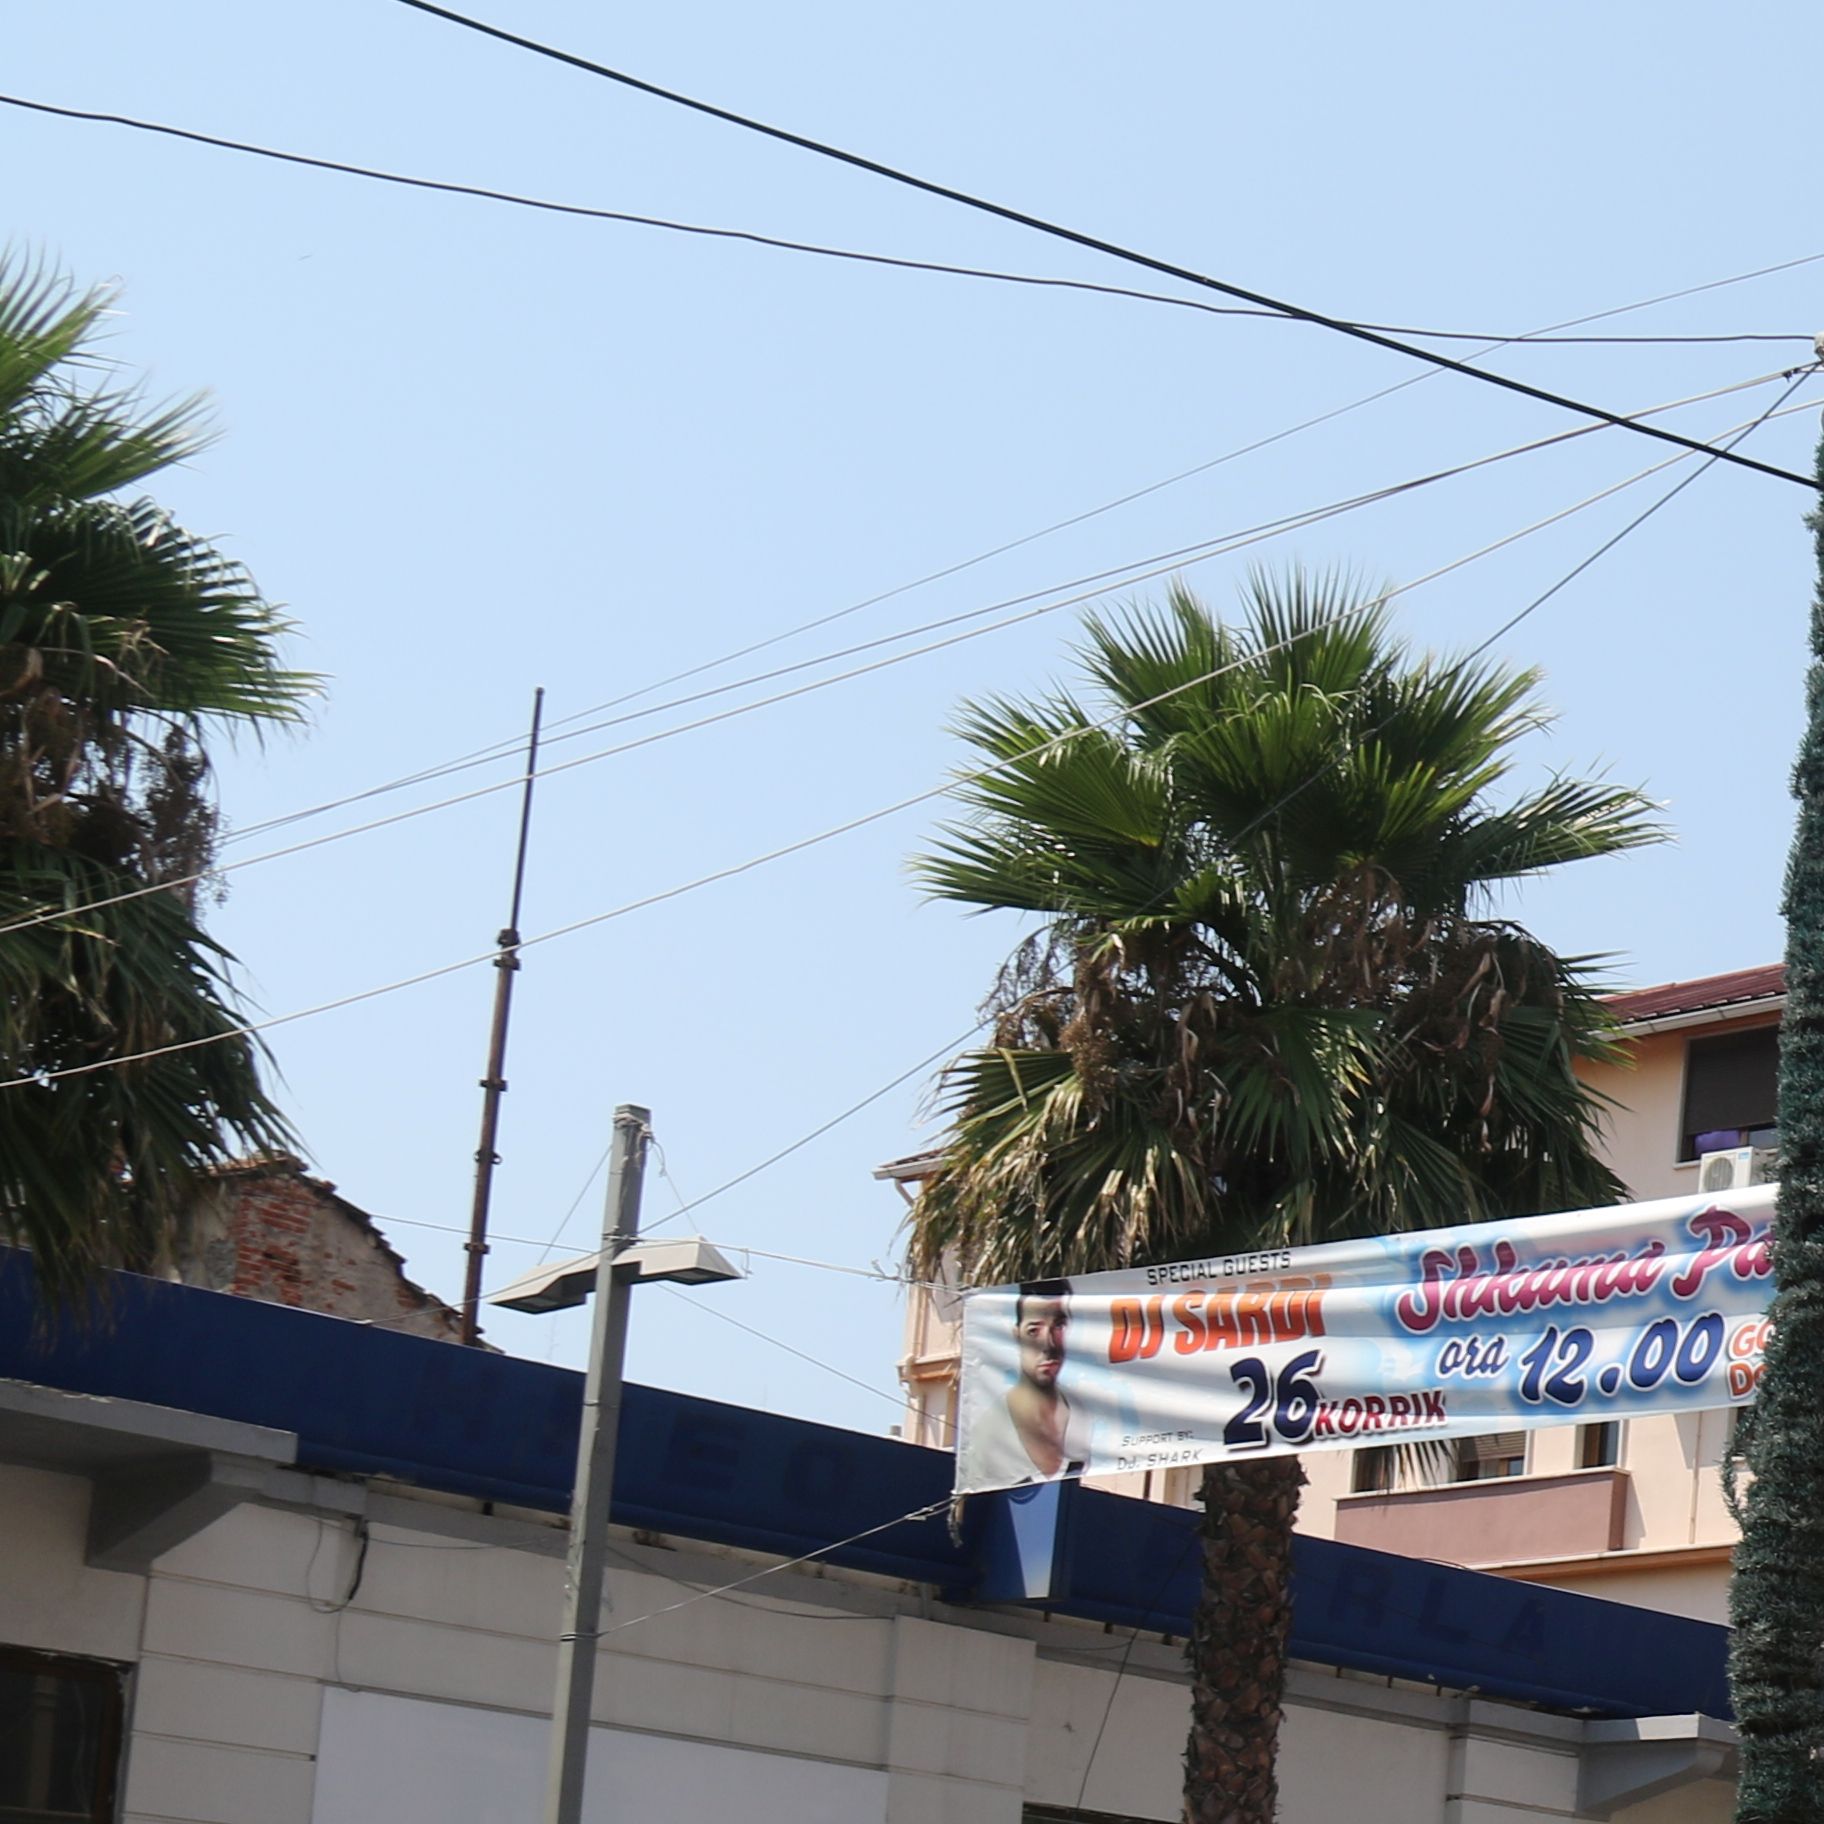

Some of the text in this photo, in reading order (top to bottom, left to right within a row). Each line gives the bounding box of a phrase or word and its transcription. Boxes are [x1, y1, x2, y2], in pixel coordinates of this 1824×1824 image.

[1147, 1250, 1291, 1286] SPECIAL GUESTS
[1397, 1239, 1666, 1333] Shkuma
[1108, 1273, 1332, 1363] DJ SARDI
[1437, 1334, 1510, 1378] ora
[1518, 1311, 1725, 1406] 12.00
[1224, 1350, 1447, 1449] 26 KORRIK
[1146, 1450, 1203, 1467] SHARK
